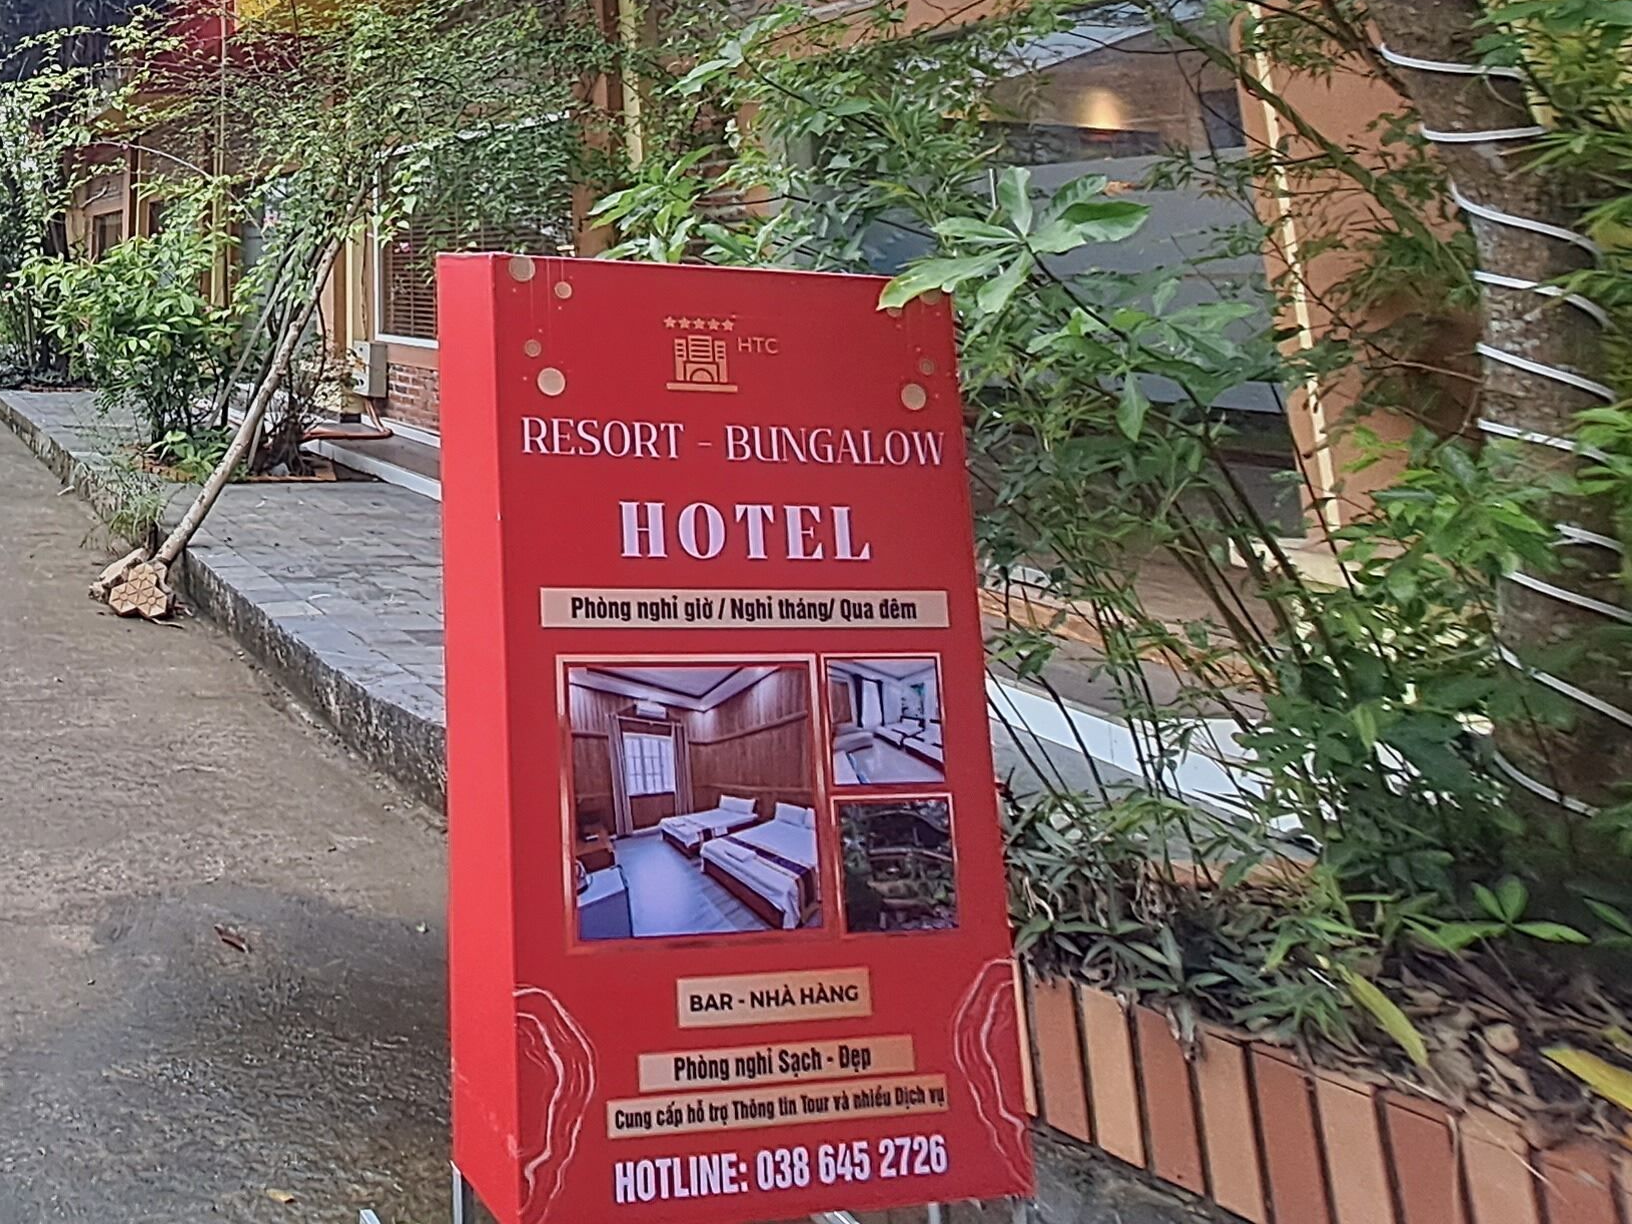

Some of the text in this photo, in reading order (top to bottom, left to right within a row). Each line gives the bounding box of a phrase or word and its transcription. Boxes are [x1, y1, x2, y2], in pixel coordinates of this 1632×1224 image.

[737, 336, 779, 354] HTC
[520, 415, 685, 460] RESORT
[725, 424, 945, 467] BUNGALOW
[618, 500, 871, 560] HOTEL
[571, 596, 631, 622] Phòng
[637, 595, 678, 622] nghỉ
[684, 597, 713, 622] giờ
[840, 598, 874, 622] Qua
[879, 598, 917, 620] đêm
[689, 993, 733, 1012] BAR
[750, 984, 795, 1009] NHÀ
[800, 982, 859, 1005] HÀNG
[674, 1054, 729, 1081] Phòng
[735, 1047, 773, 1079] nghỉ
[779, 1047, 823, 1077] Sạch
[838, 1044, 871, 1073] Đẹp
[614, 1110, 652, 1130] Cung
[656, 1101, 683, 1127] cấp
[732, 1099, 775, 1121] Thông
[779, 1096, 797, 1116] tin
[800, 1095, 829, 1114] Tour
[833, 1090, 850, 1111] và
[895, 1085, 925, 1110] Dịch
[928, 1087, 945, 1107] vụ
[614, 1134, 948, 1204] HOTLINE: 038 645 2726
